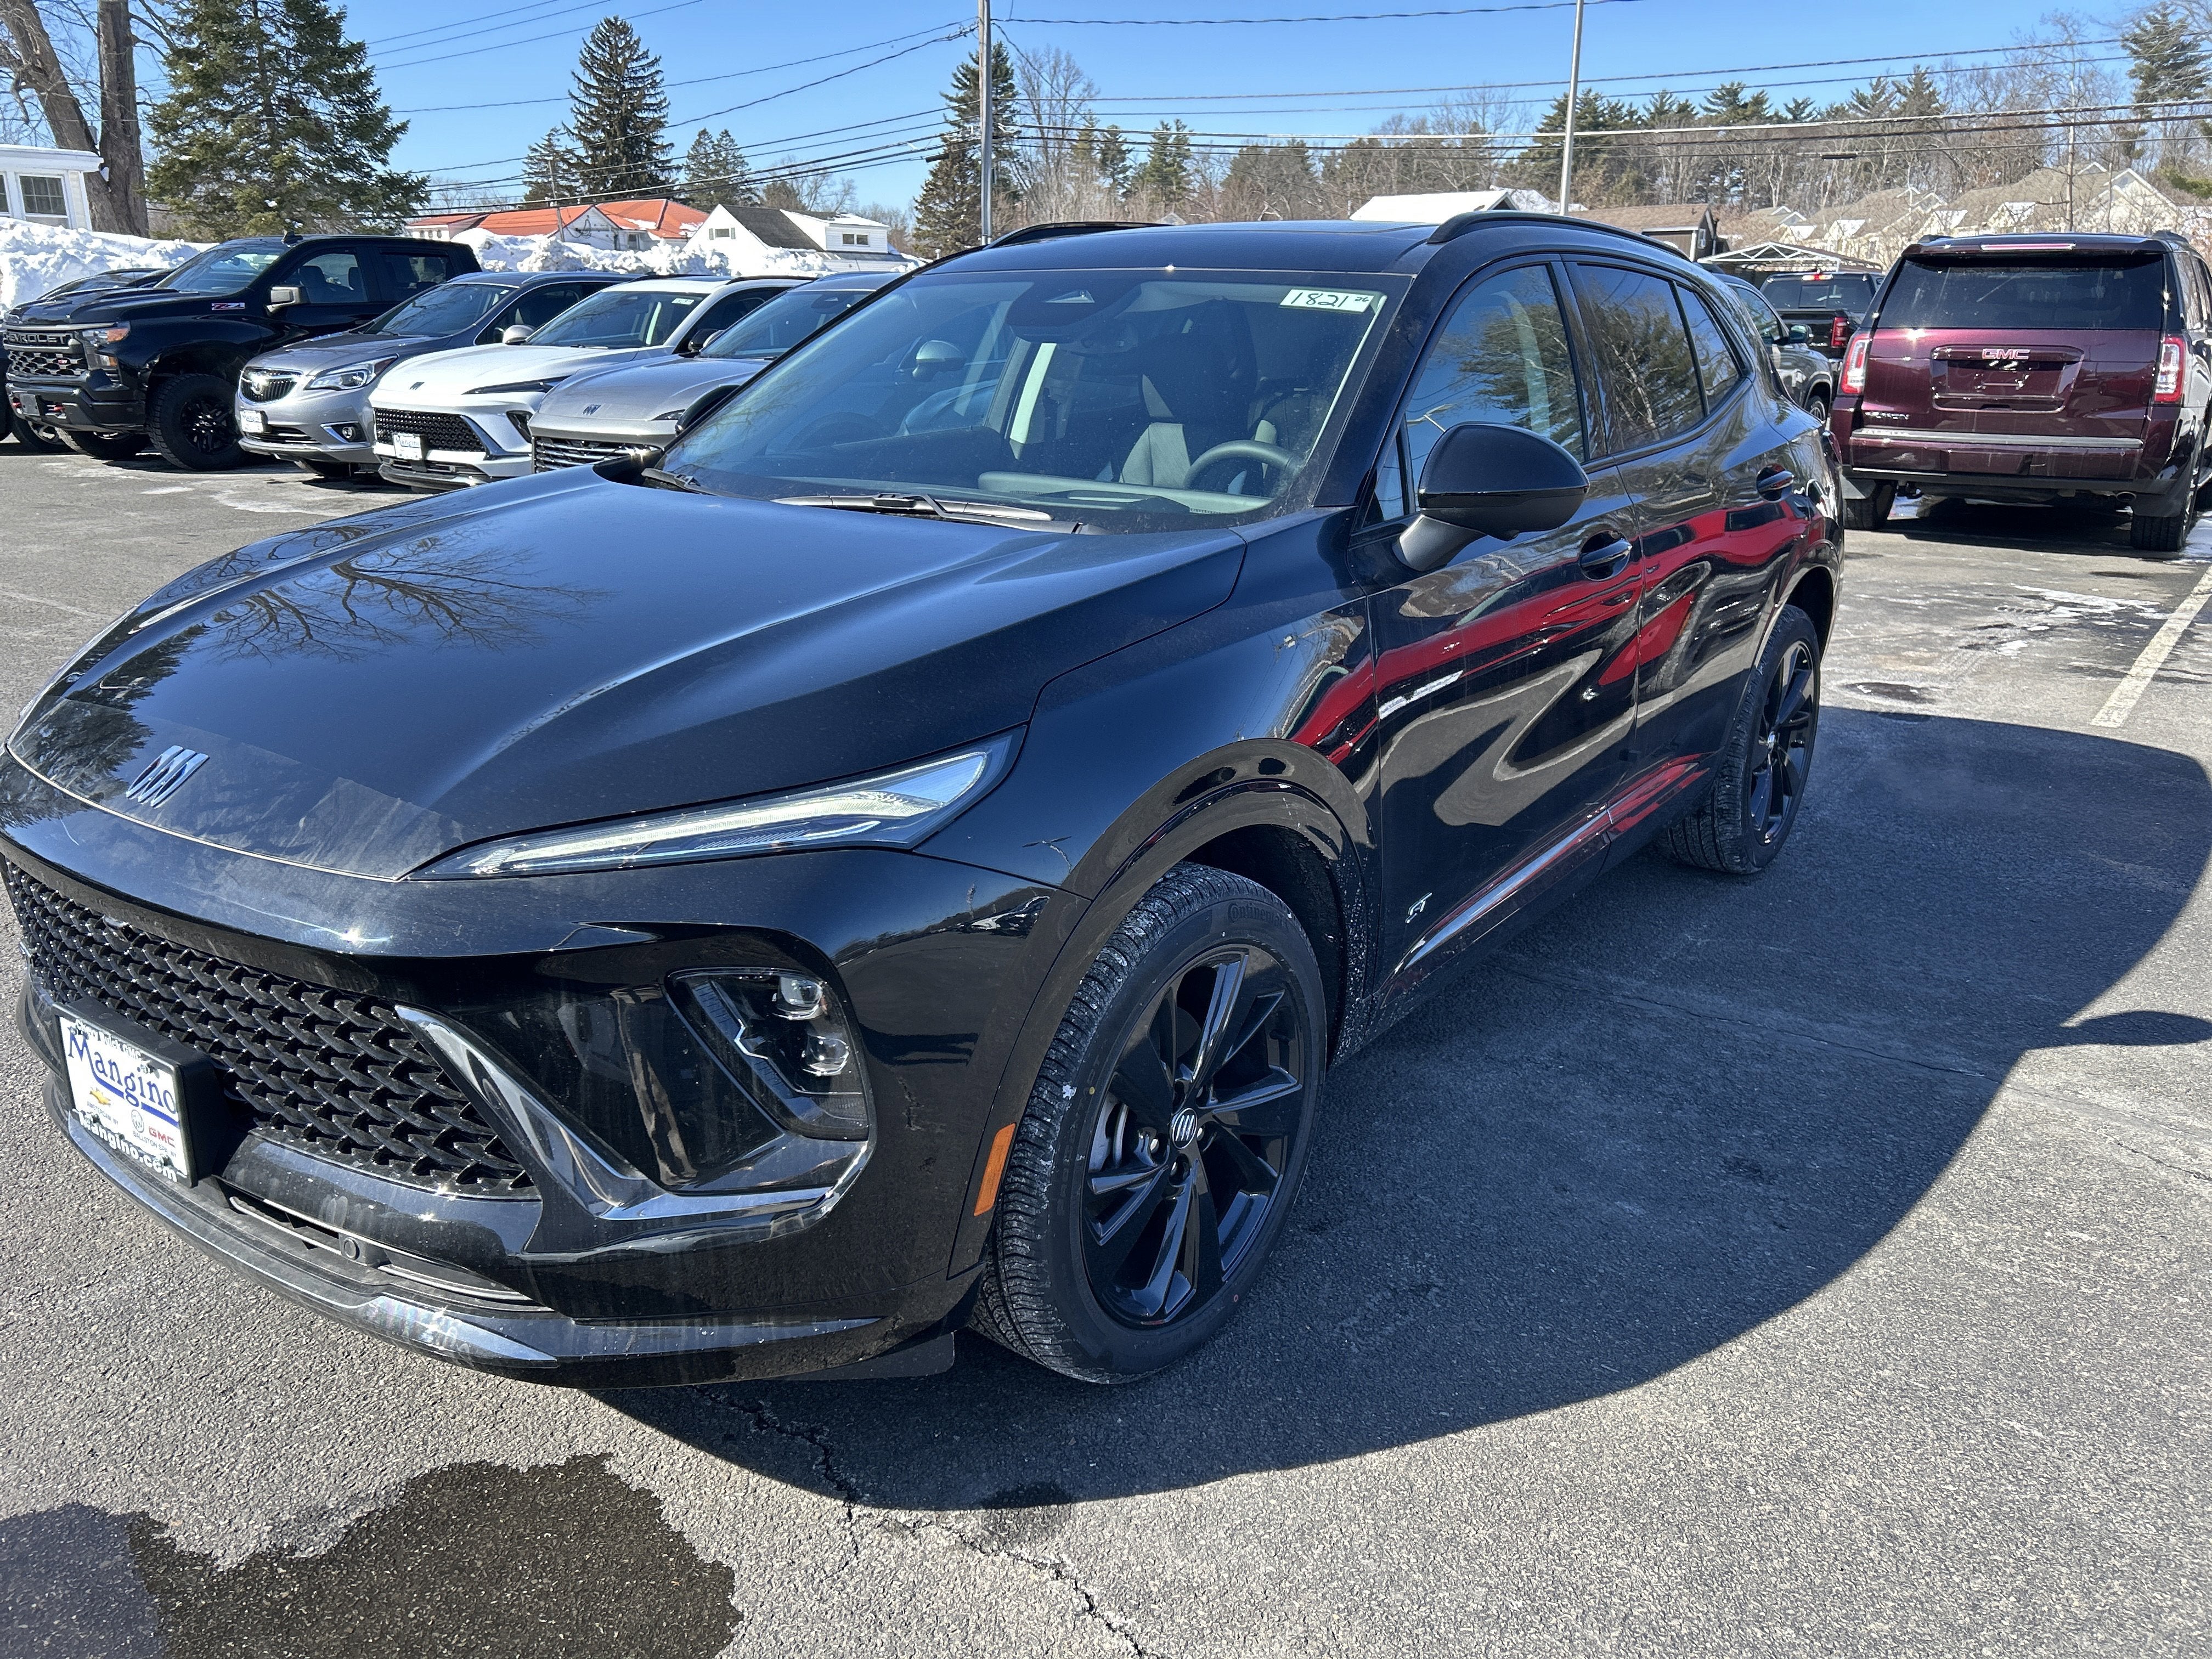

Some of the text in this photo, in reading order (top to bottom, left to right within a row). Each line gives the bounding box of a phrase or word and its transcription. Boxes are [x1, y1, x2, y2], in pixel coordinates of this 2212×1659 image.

[1291, 292, 1349, 307] 1821
[1982, 348, 2030, 360] GMC
[67, 1026, 176, 1114] Mangino
[149, 1126, 176, 1148] GMC
